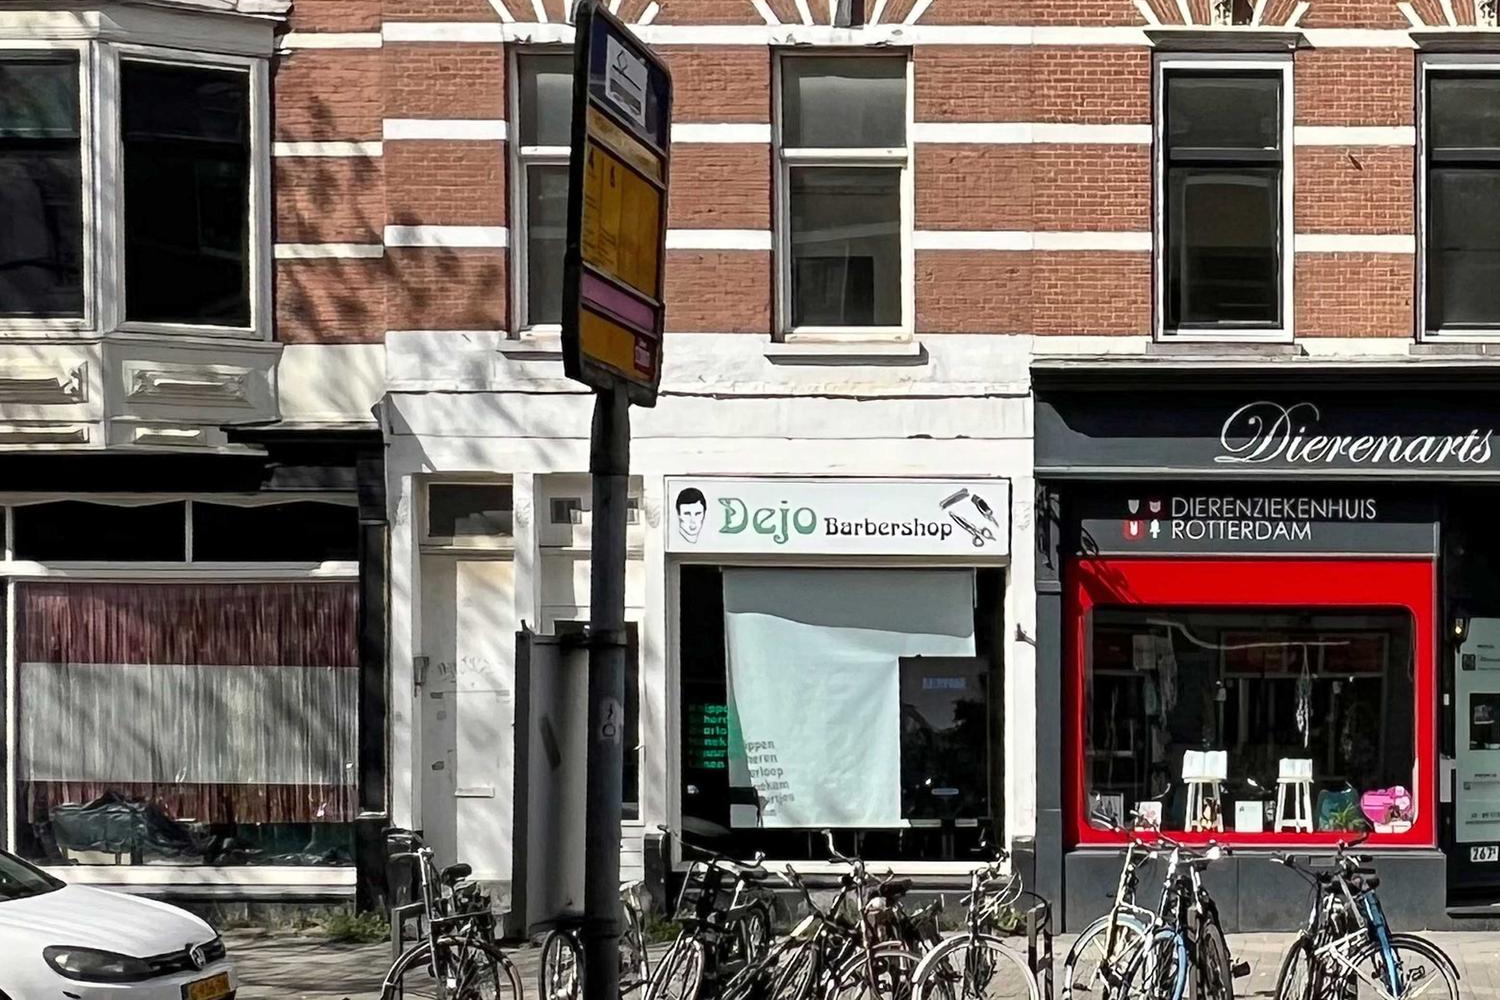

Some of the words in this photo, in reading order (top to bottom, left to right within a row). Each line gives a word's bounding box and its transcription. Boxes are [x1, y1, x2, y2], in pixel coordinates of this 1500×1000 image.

[1213, 401, 1494, 464] Dierenarts
[718, 497, 817, 545] Dejo
[824, 517, 952, 541] Barbershop
[1171, 496, 1377, 520] DIERENZIEKENHUIS
[1171, 519, 1312, 541] ROTTERDAM
